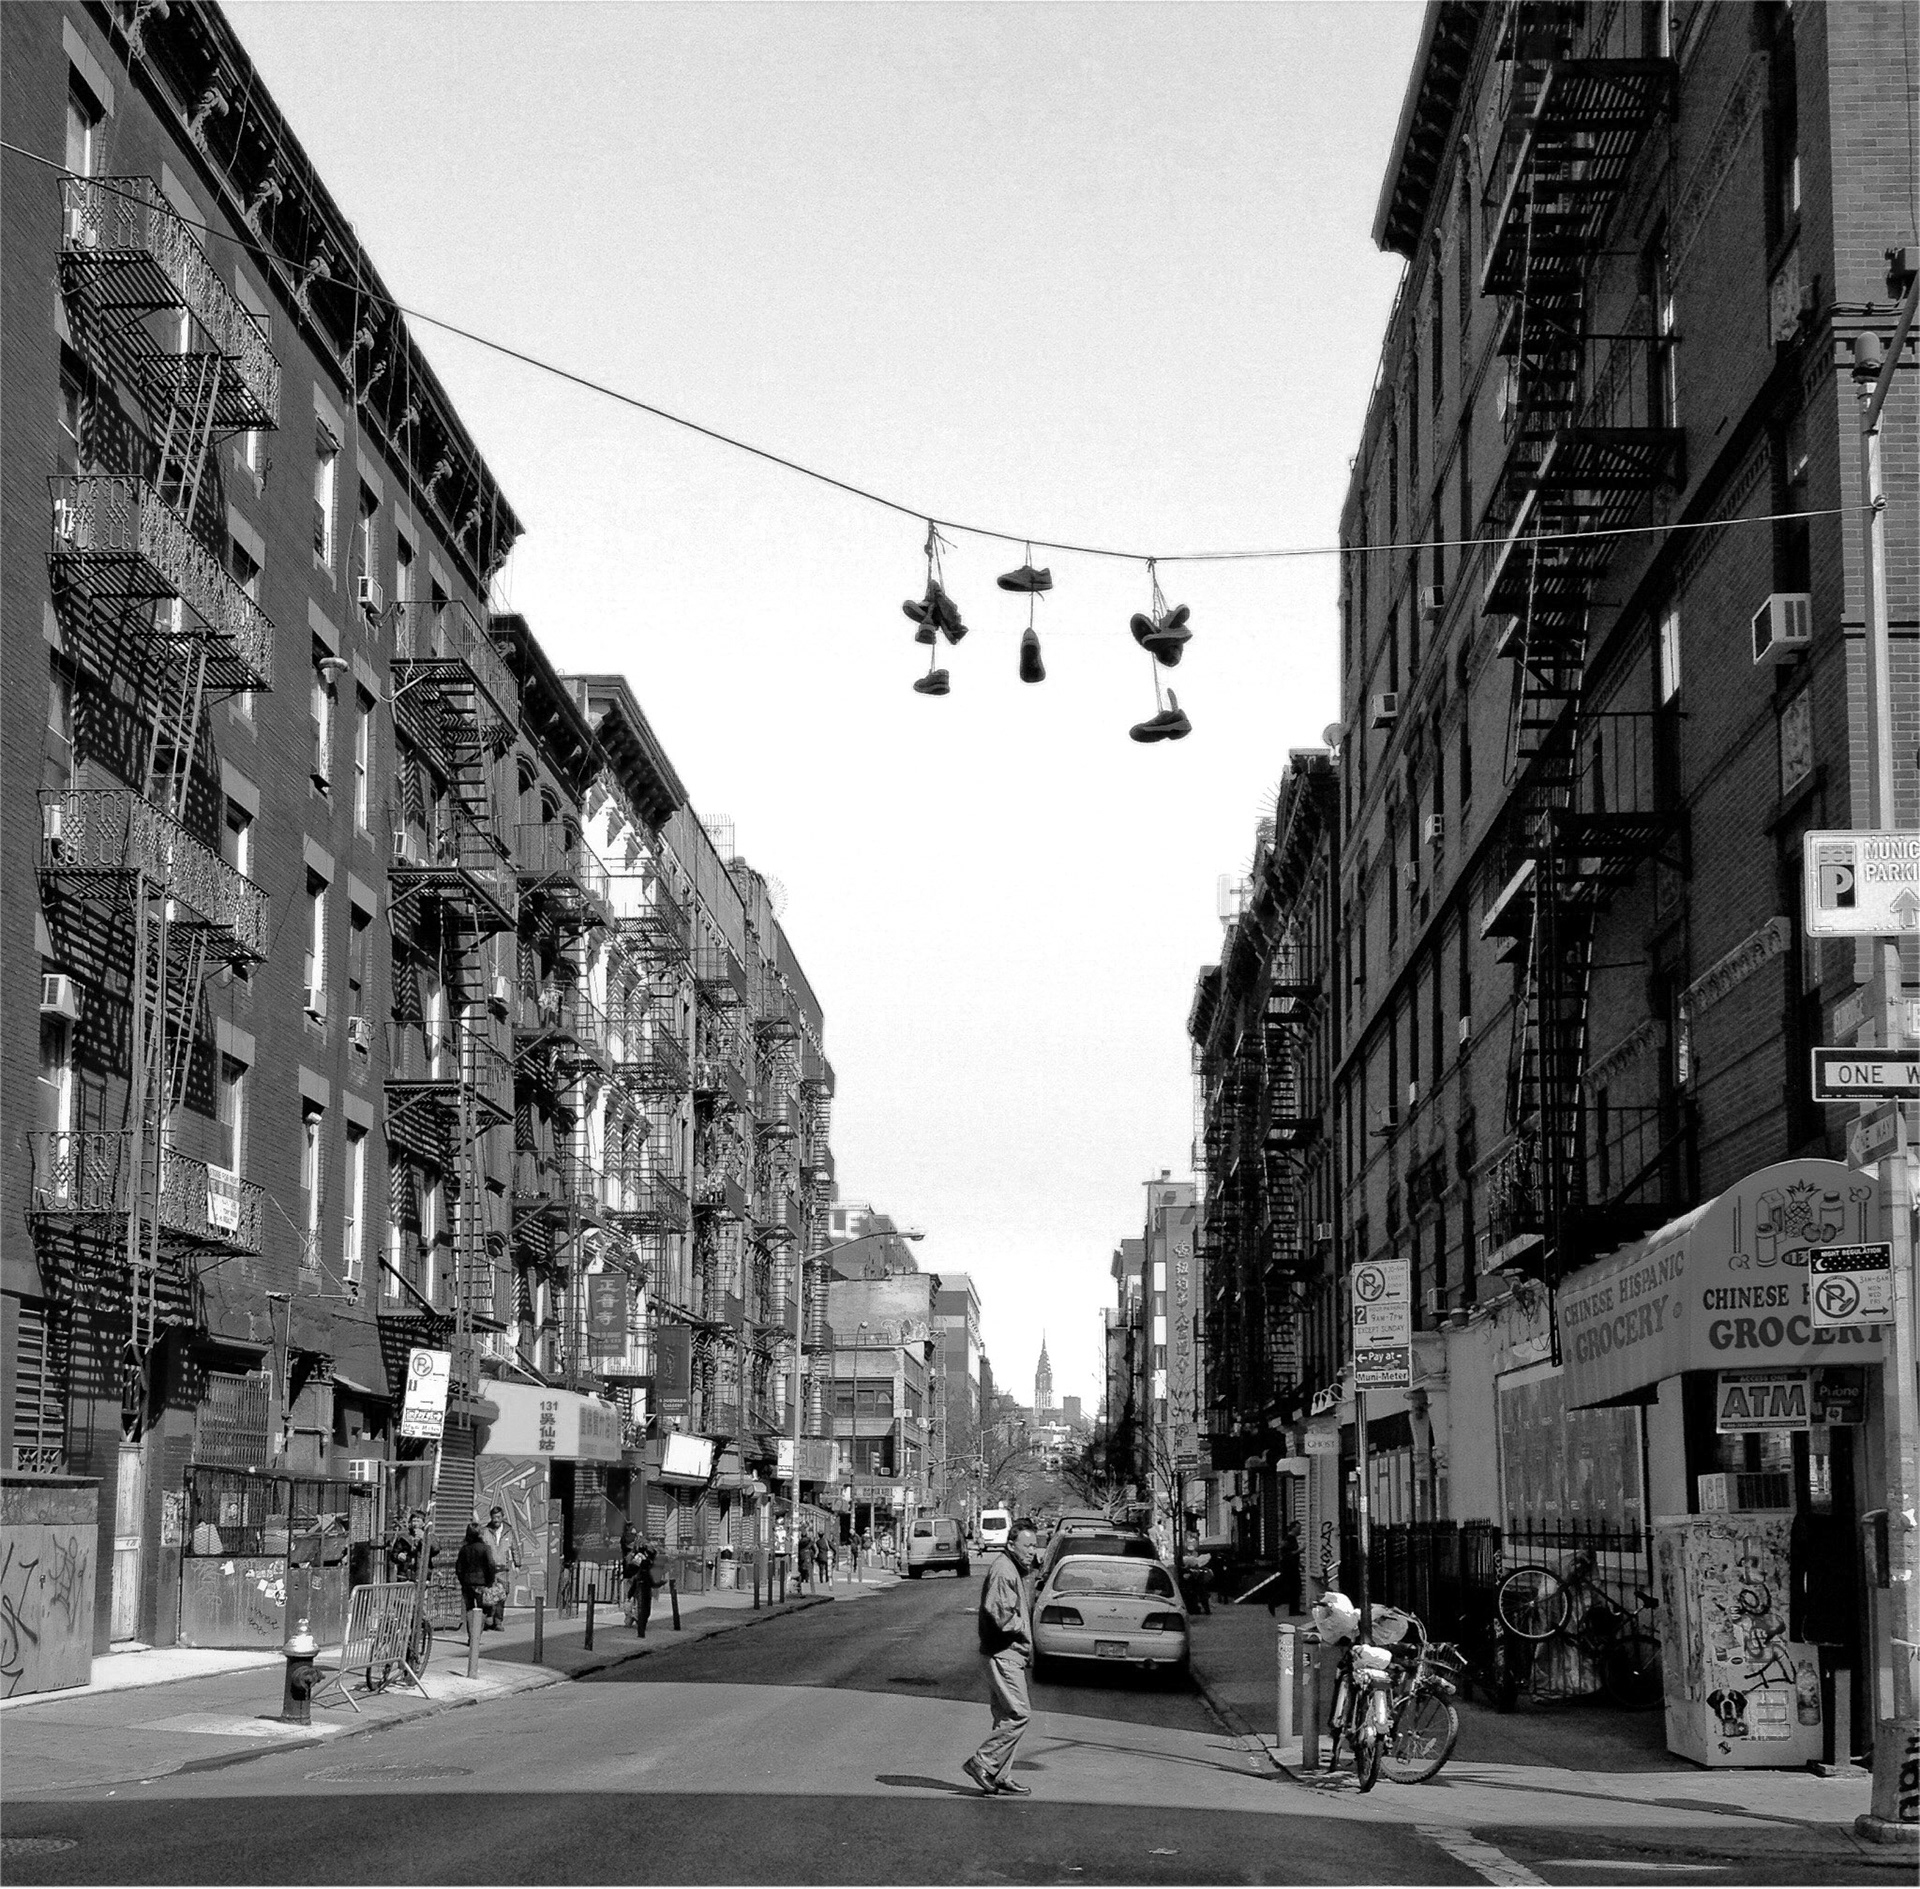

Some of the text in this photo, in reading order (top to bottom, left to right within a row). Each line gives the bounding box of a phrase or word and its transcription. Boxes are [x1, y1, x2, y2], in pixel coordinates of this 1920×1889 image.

[1839, 1065, 1884, 1084] ONE
[1841, 1247, 1882, 1256] REGULATION
[1564, 1250, 1684, 1328] CHINESE HISPANIC
[1702, 1284, 1789, 1310] CHINESE
[1356, 1308, 1366, 1324] 2
[1576, 1294, 1669, 1364] GROCERY
[1368, 1351, 1395, 1363] Pay at
[1357, 1372, 1406, 1381] Muni-Meter
[540, 1401, 558, 1411] 131
[1721, 1385, 1806, 1418] ATM
